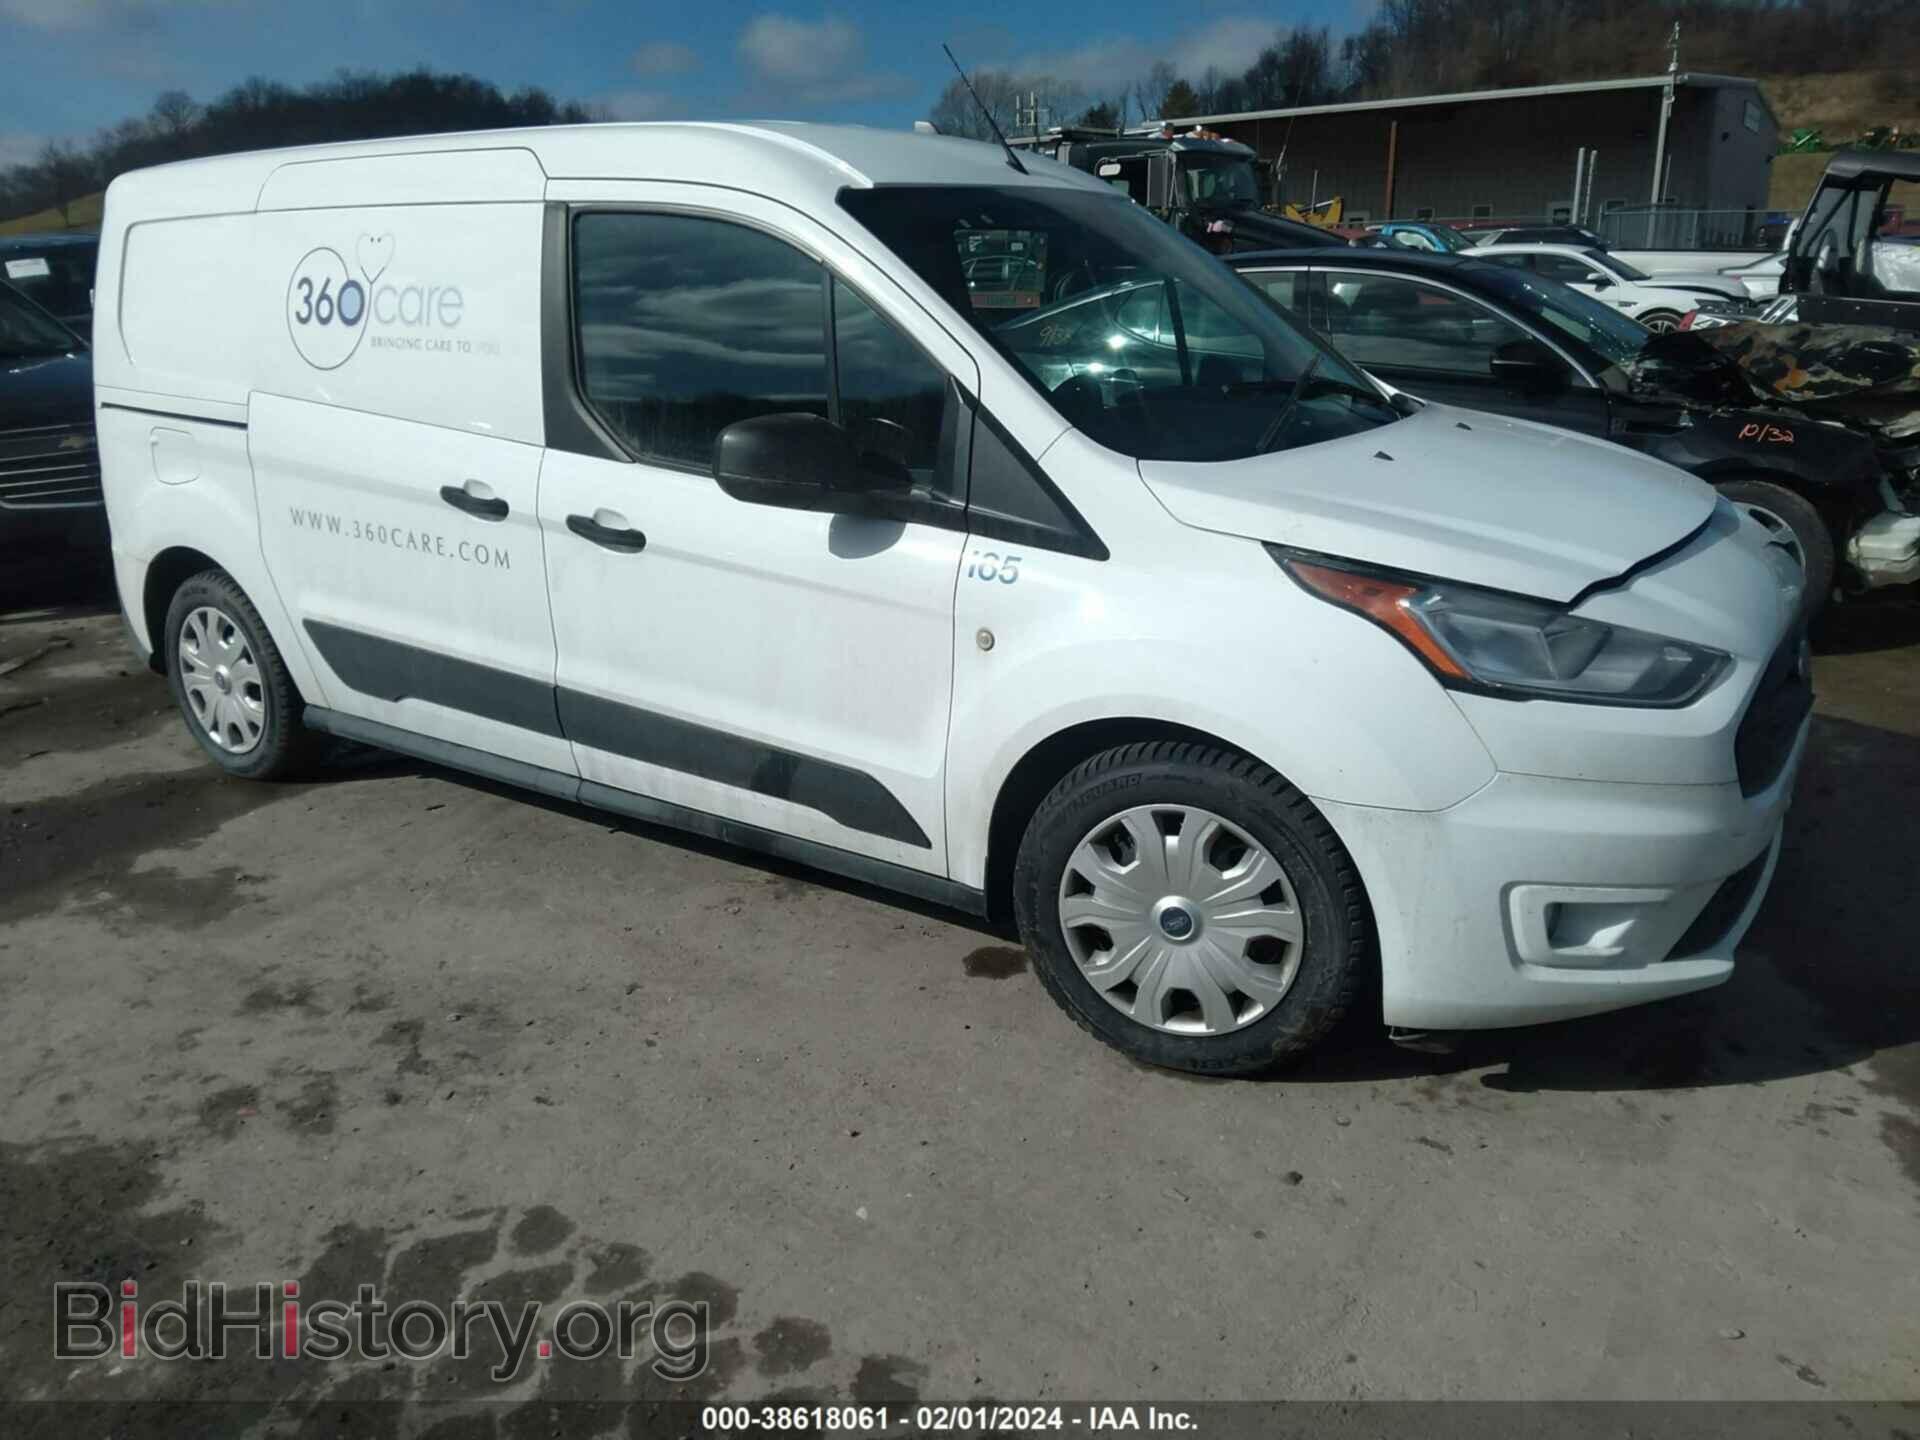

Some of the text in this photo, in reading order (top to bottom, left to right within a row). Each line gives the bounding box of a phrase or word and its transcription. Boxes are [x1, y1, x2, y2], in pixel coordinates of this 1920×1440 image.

[295, 276, 464, 328] 360 care
[370, 336, 422, 351] BRINGING
[425, 339, 451, 353] CARE
[457, 340, 471, 353] TO
[289, 506, 511, 569] WWW.360CARE.COM
